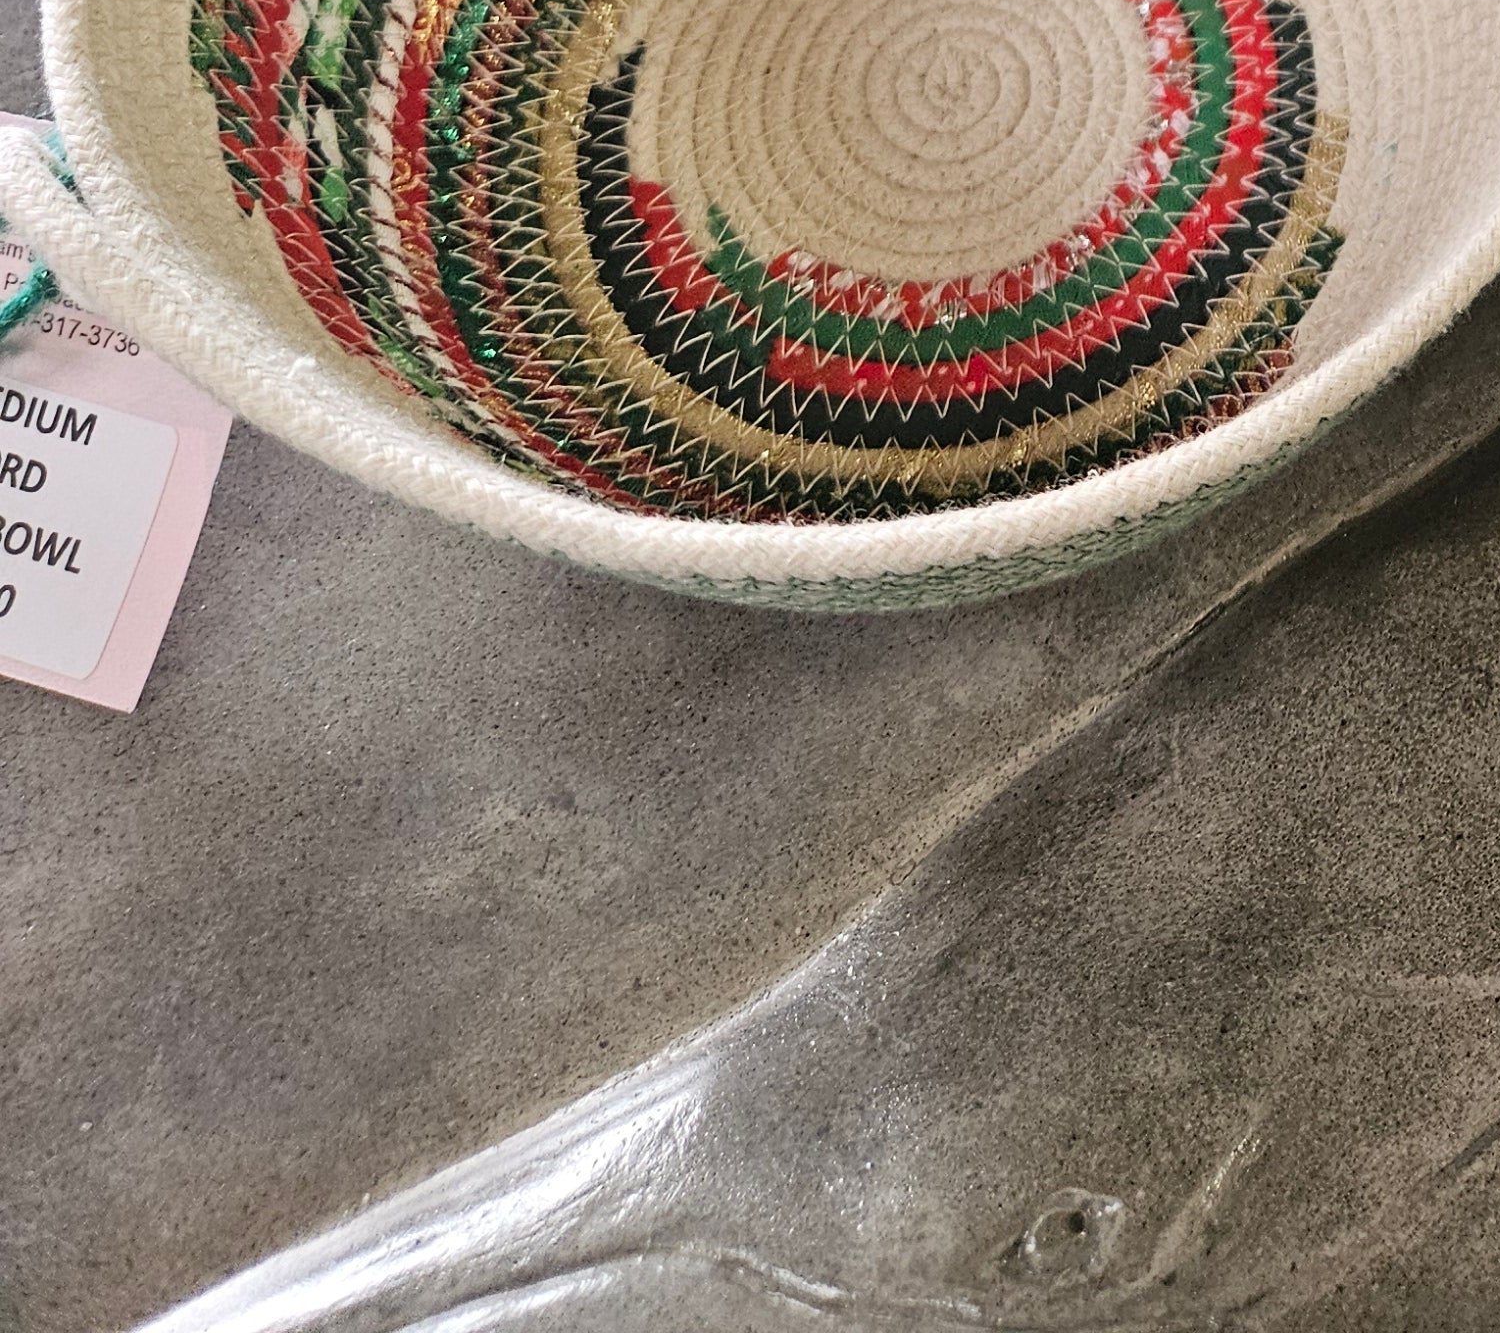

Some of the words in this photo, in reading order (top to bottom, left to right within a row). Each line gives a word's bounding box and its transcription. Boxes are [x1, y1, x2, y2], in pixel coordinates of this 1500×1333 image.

[21, 311, 141, 357] -317-3736
[0, 387, 98, 446] DIUM
[0, 451, 48, 493] RD
[0, 515, 82, 574] OWL
